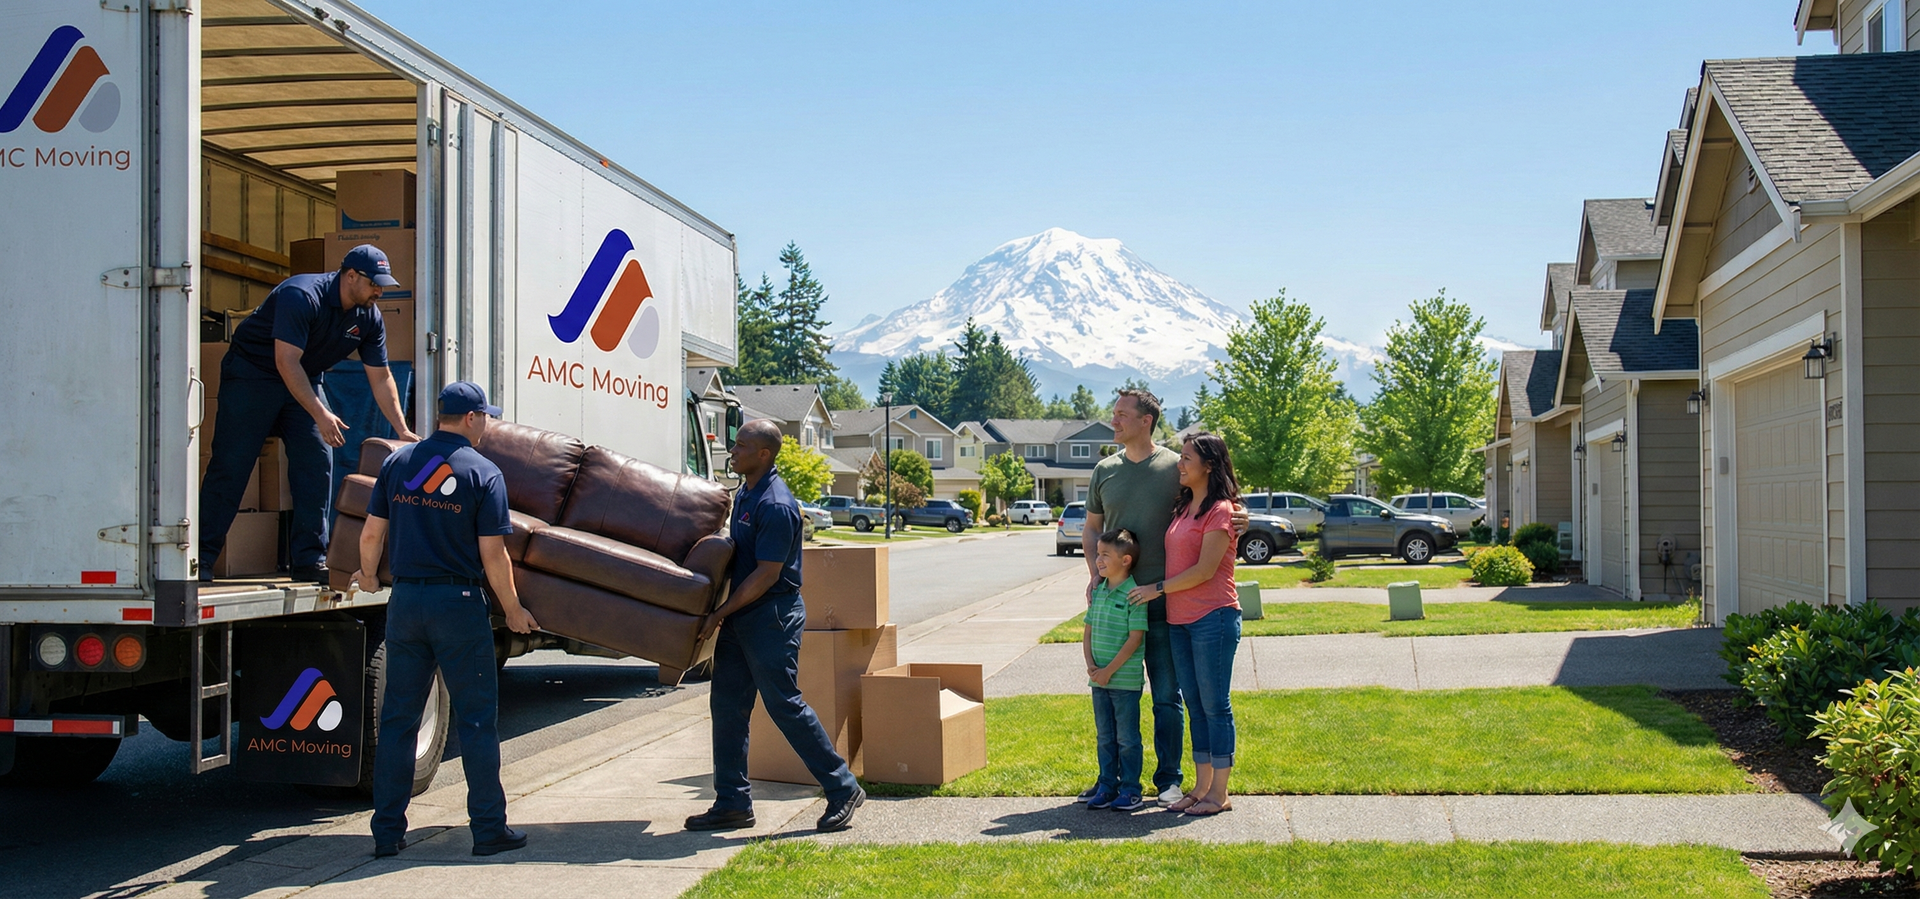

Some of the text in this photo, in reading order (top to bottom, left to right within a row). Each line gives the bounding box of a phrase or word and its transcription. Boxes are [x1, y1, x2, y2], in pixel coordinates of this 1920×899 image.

[35, 145, 130, 171] Moving
[527, 355, 669, 409] AMC Moving
[392, 493, 462, 514] AMC Moving
[247, 738, 352, 758] AMC Moving
